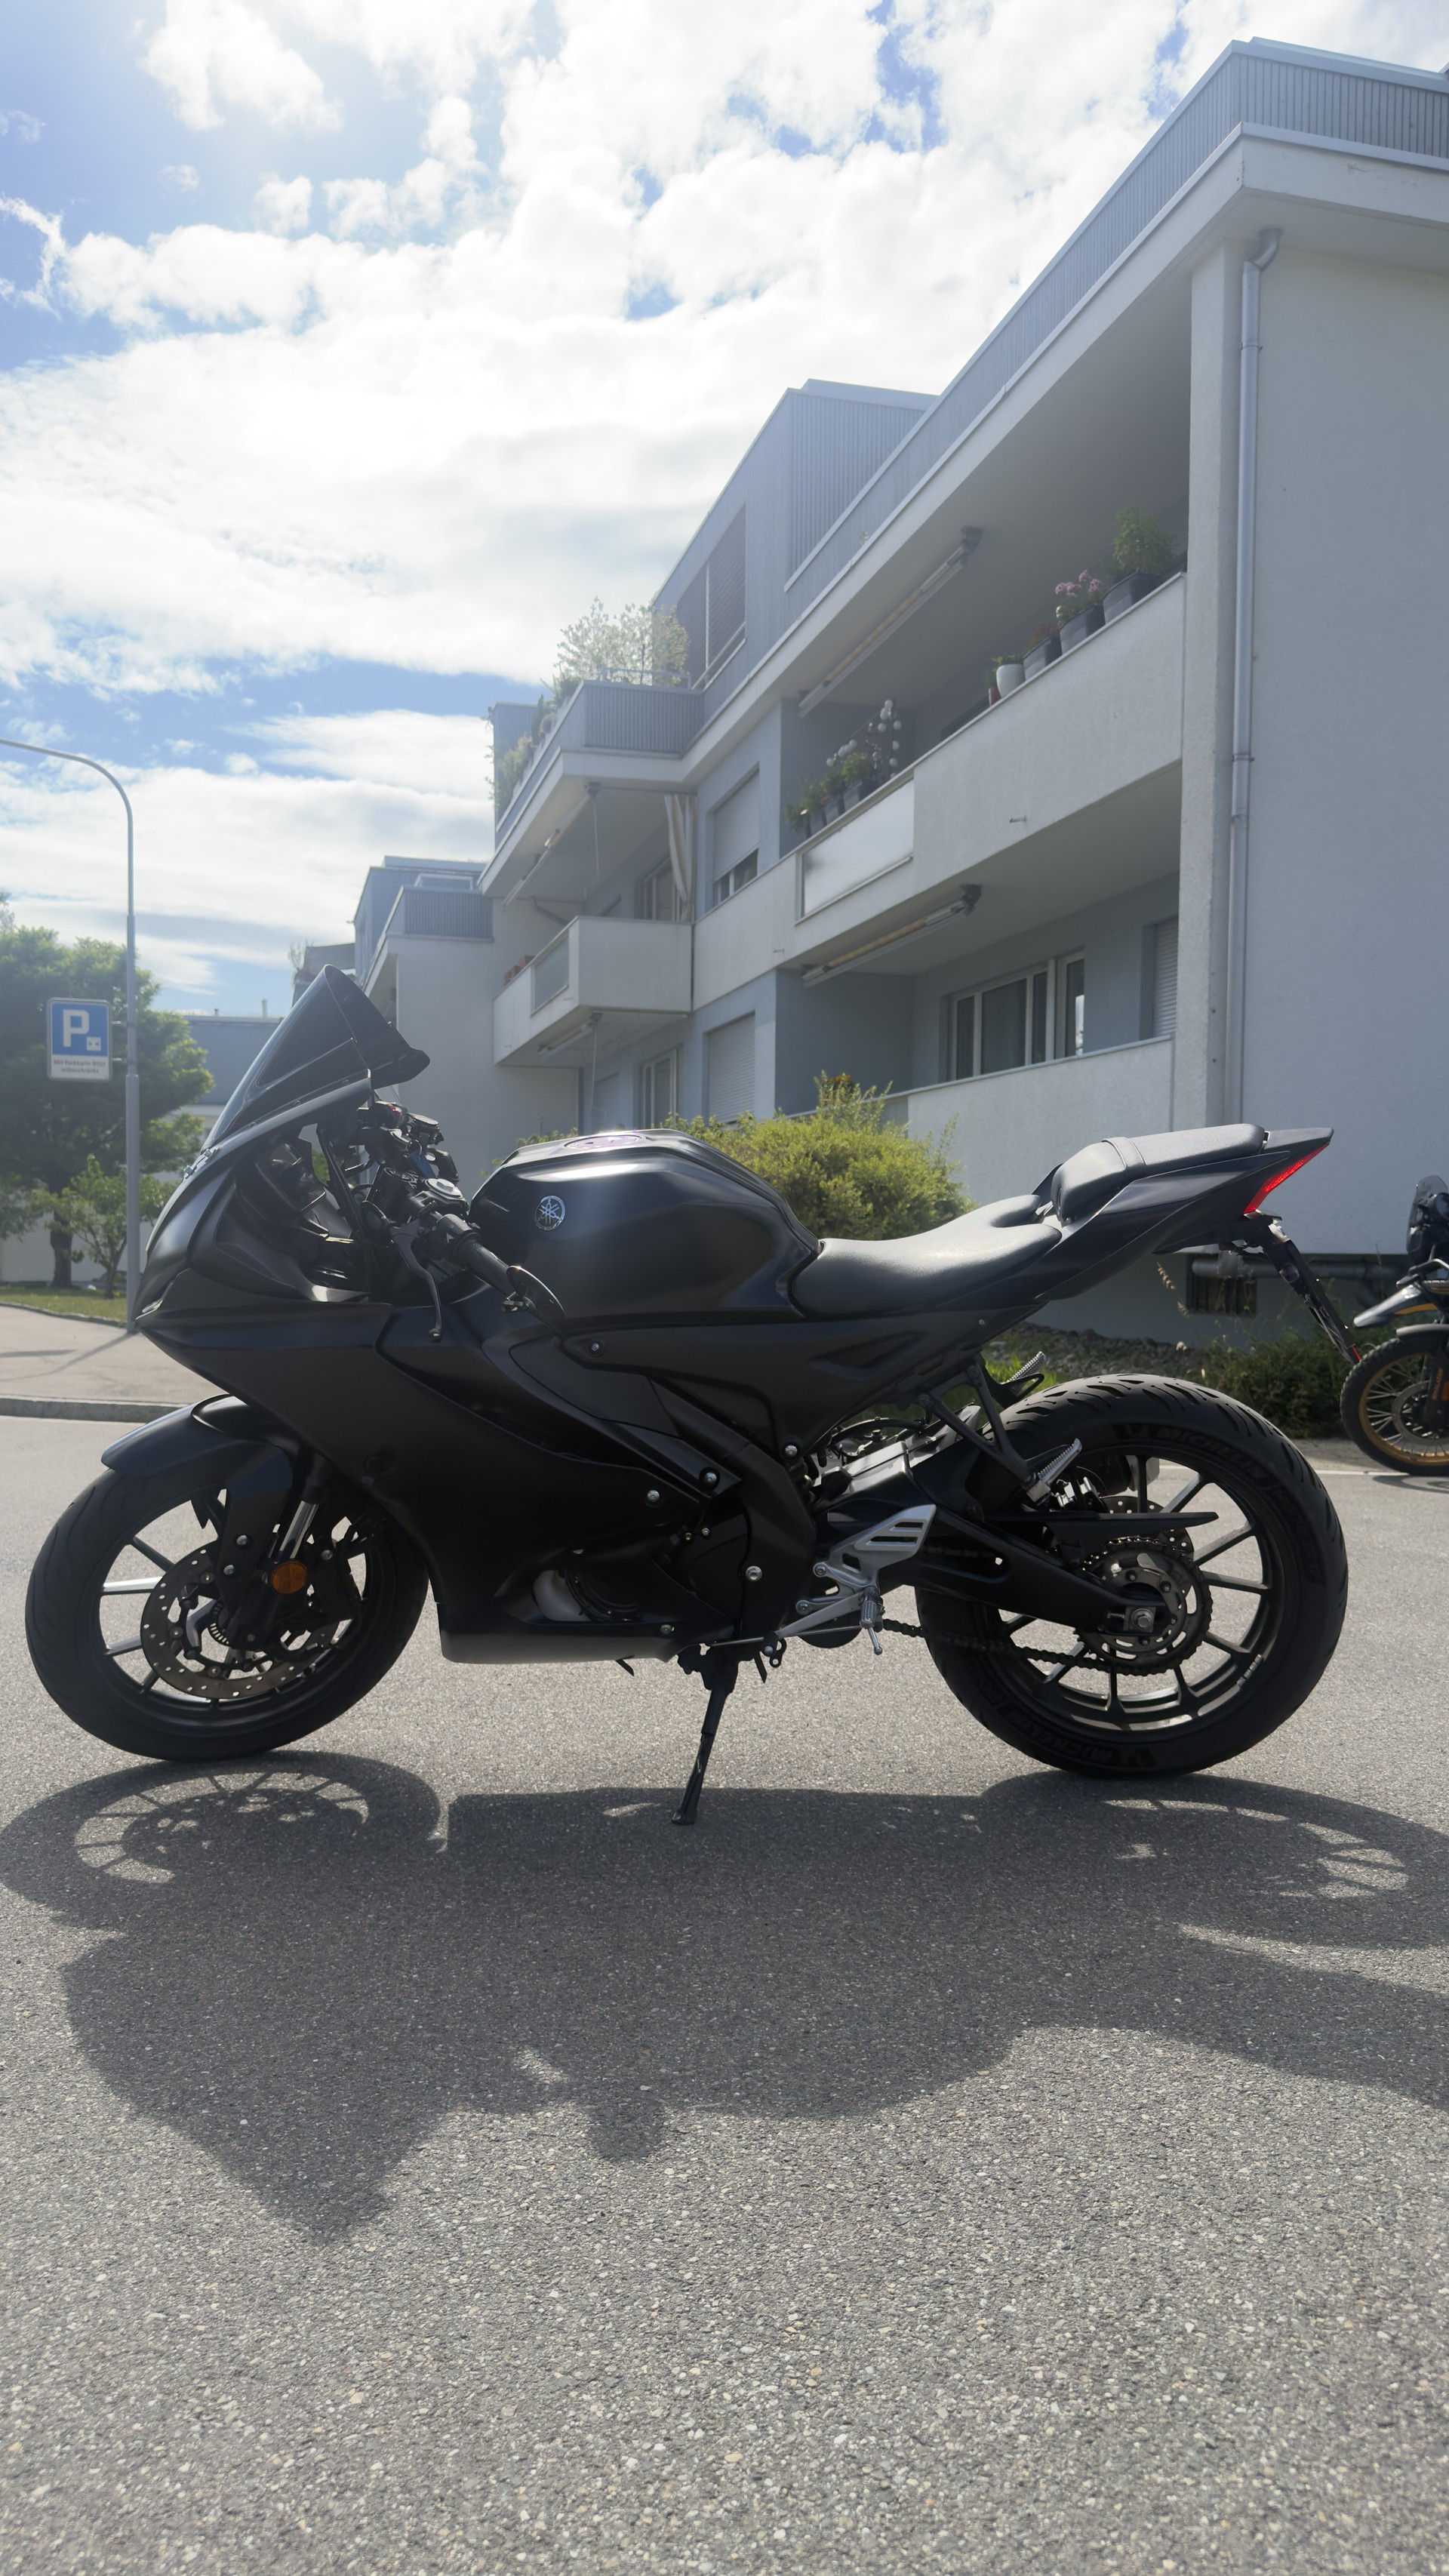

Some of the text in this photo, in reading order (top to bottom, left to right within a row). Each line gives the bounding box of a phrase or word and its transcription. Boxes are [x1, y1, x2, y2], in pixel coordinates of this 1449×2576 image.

[63, 1009, 89, 1047] P
[1160, 1424, 1270, 1484] MICHELIN
[1004, 1708, 1114, 1766] MICHELIN
